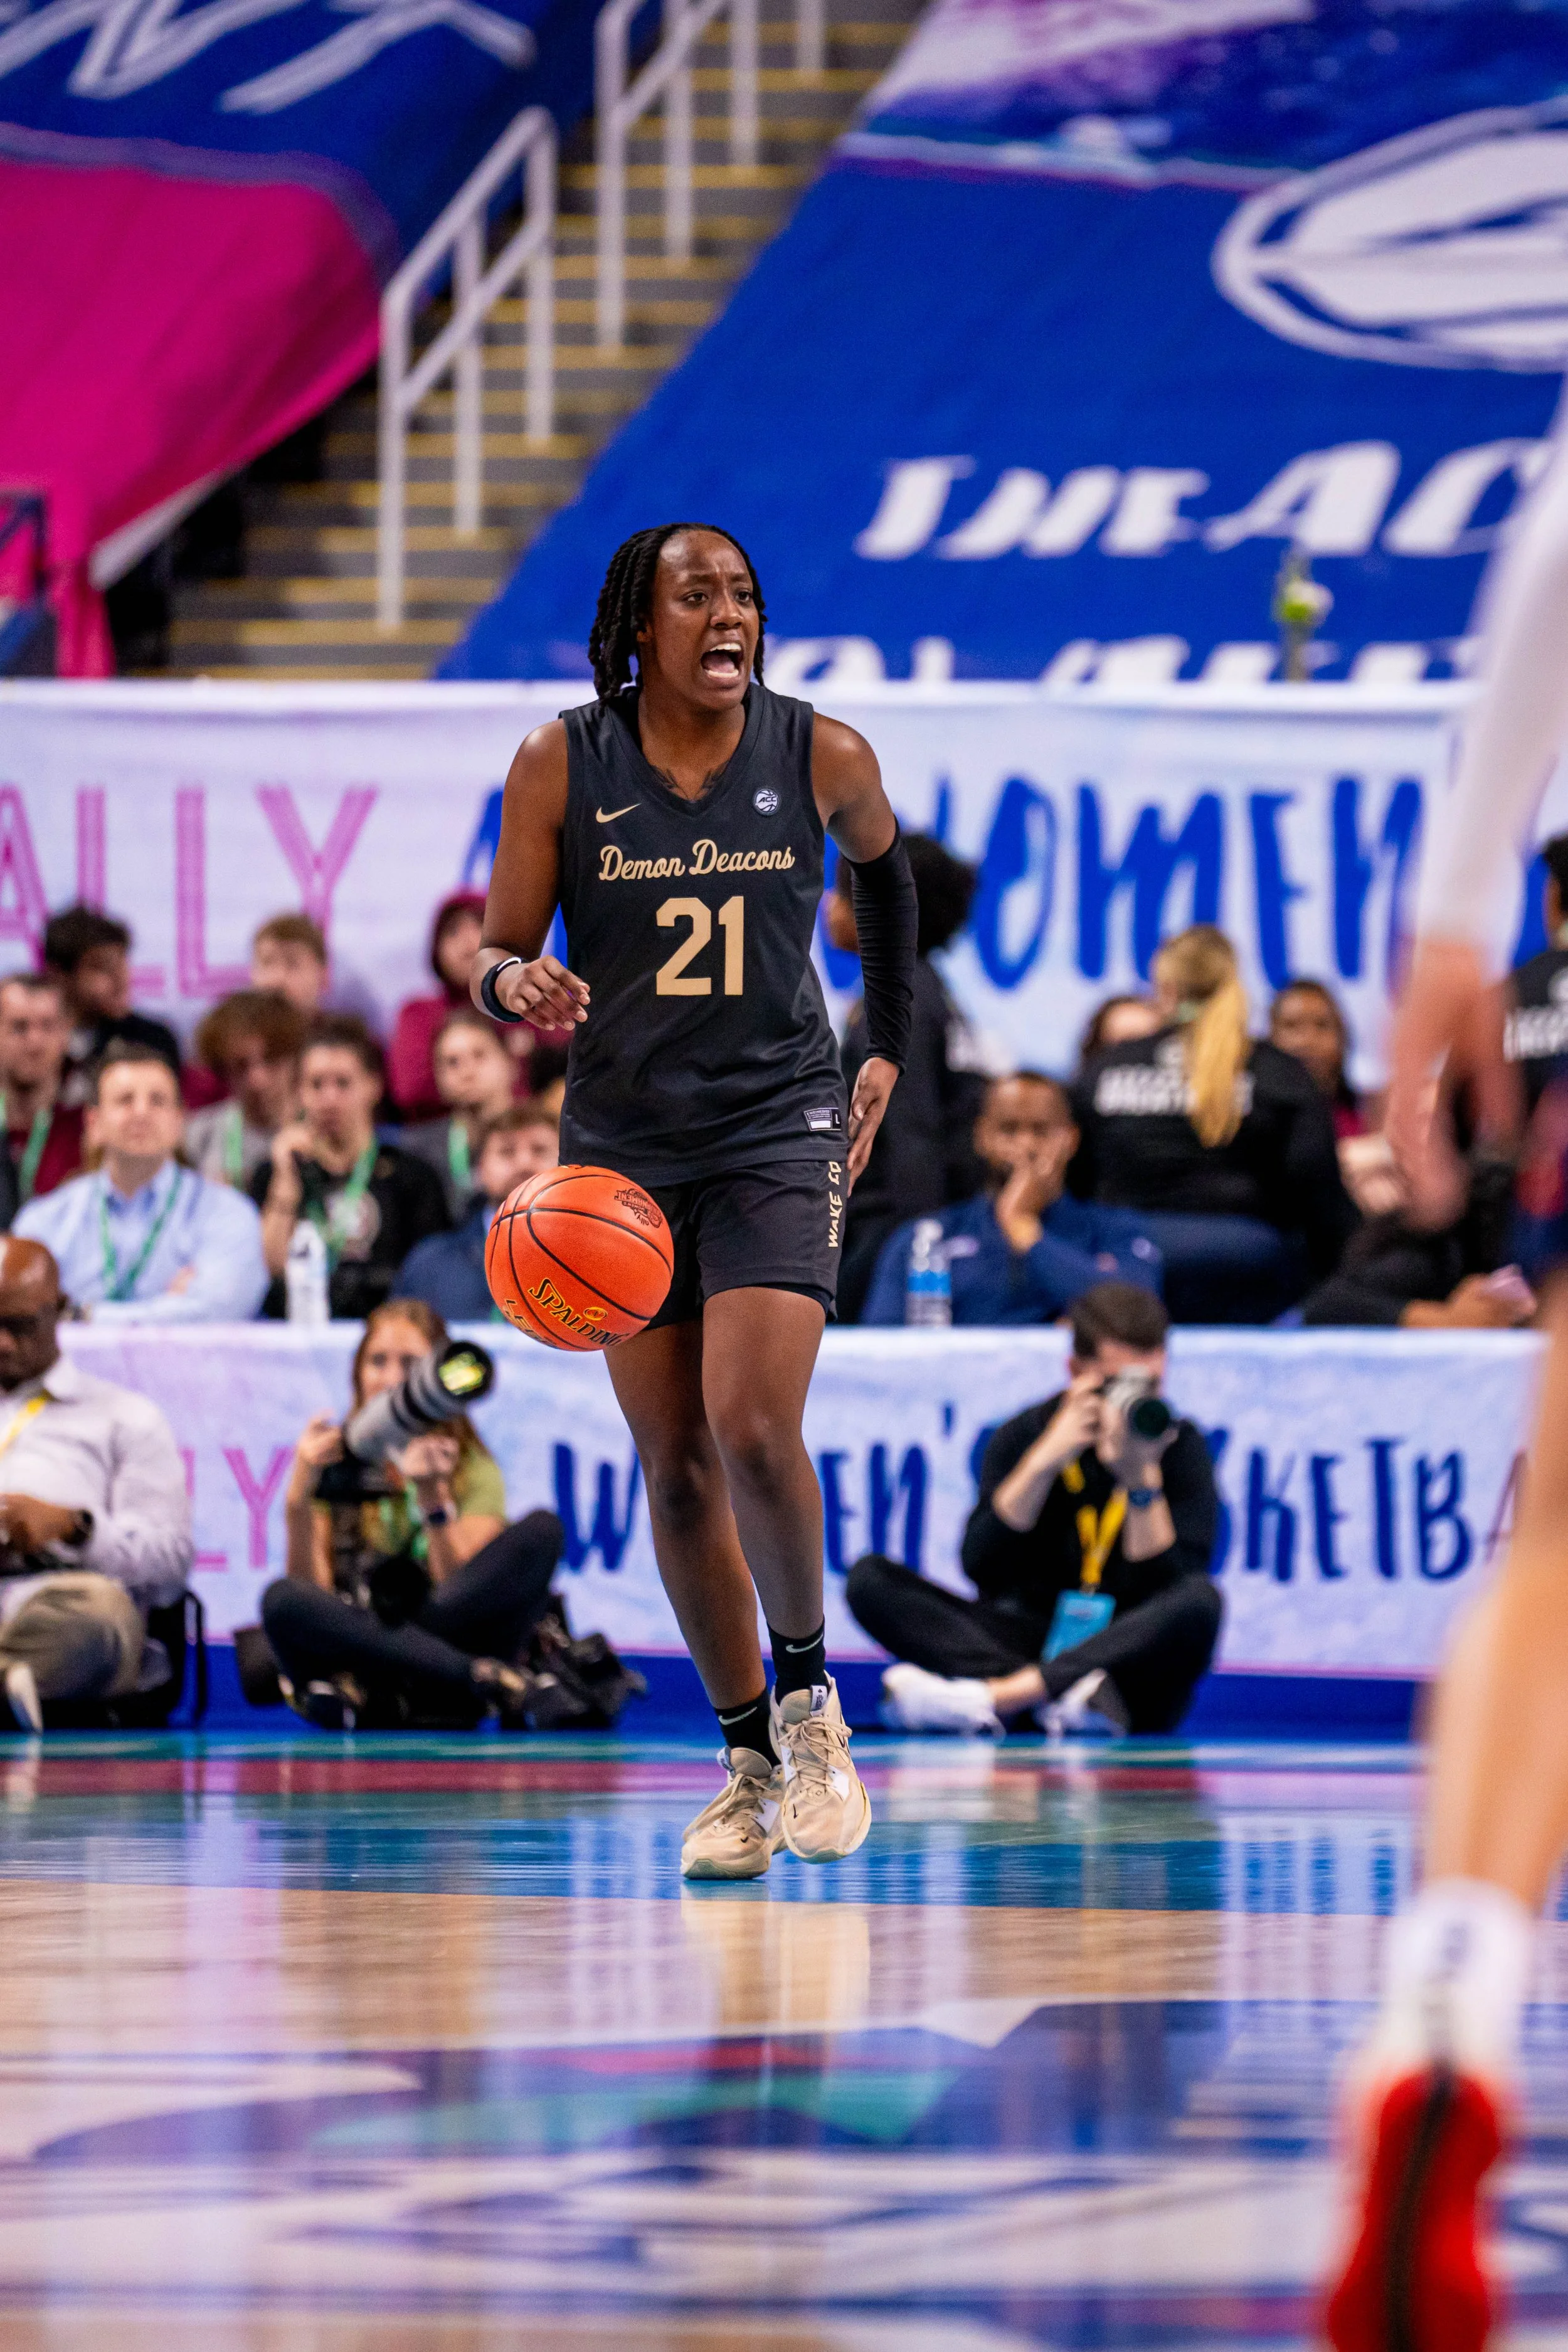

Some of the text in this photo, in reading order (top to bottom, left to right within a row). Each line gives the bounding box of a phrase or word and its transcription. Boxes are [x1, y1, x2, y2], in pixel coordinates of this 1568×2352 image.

[599, 839, 795, 881] Demon Deacons
[656, 896, 744, 996] 21
[835, 1113, 840, 1124] L
[637, 1214, 650, 1226] ally
[828, 1191, 843, 1248] WAKE
[527, 1278, 630, 1347] SPALDING
[178, 1446, 296, 1573] LY
